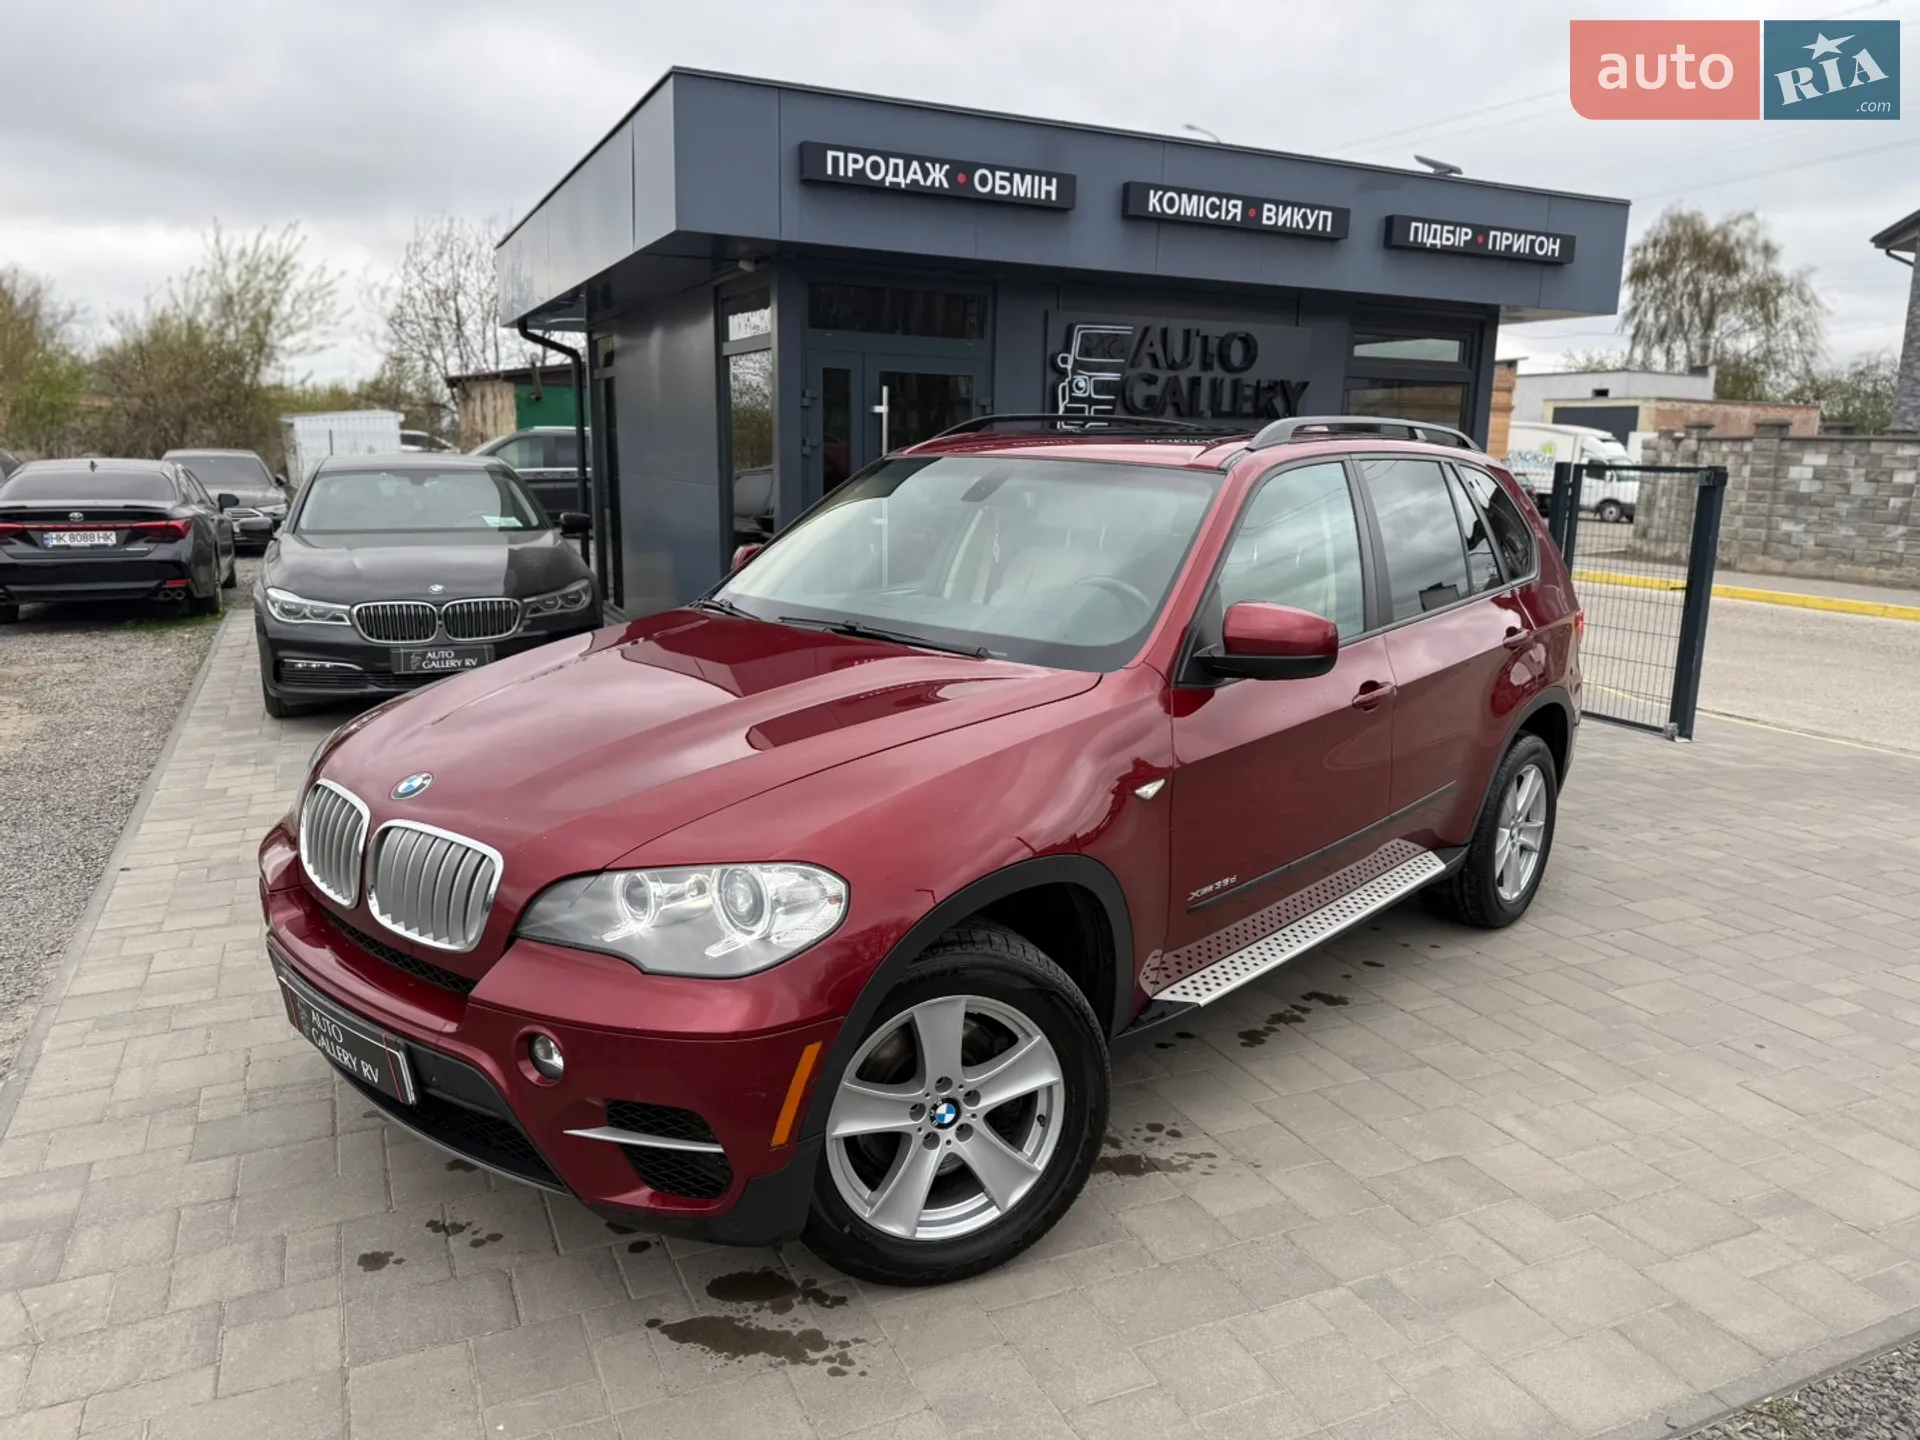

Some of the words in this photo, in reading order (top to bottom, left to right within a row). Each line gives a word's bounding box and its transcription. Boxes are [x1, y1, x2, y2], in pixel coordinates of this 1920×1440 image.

[826, 150, 950, 188] ПРОДАЖ
[973, 168, 1057, 200] ОБМІН
[1148, 190, 1242, 222] КОМІСІЯ
[1262, 203, 1332, 232] ВИКУП
[1409, 222, 1472, 248] ПІДБІР
[1488, 231, 1560, 257] ПРИГОН
[1130, 325, 1258, 373] AUTO
[1122, 373, 1310, 419] GALLERY
[422, 659, 462, 669] GALLERY
[465, 658, 478, 666] RV
[426, 651, 454, 659] AUTO
[311, 1010, 343, 1043] AUTO
[312, 1027, 357, 1072] GALLERY
[361, 1060, 379, 1083] RV
